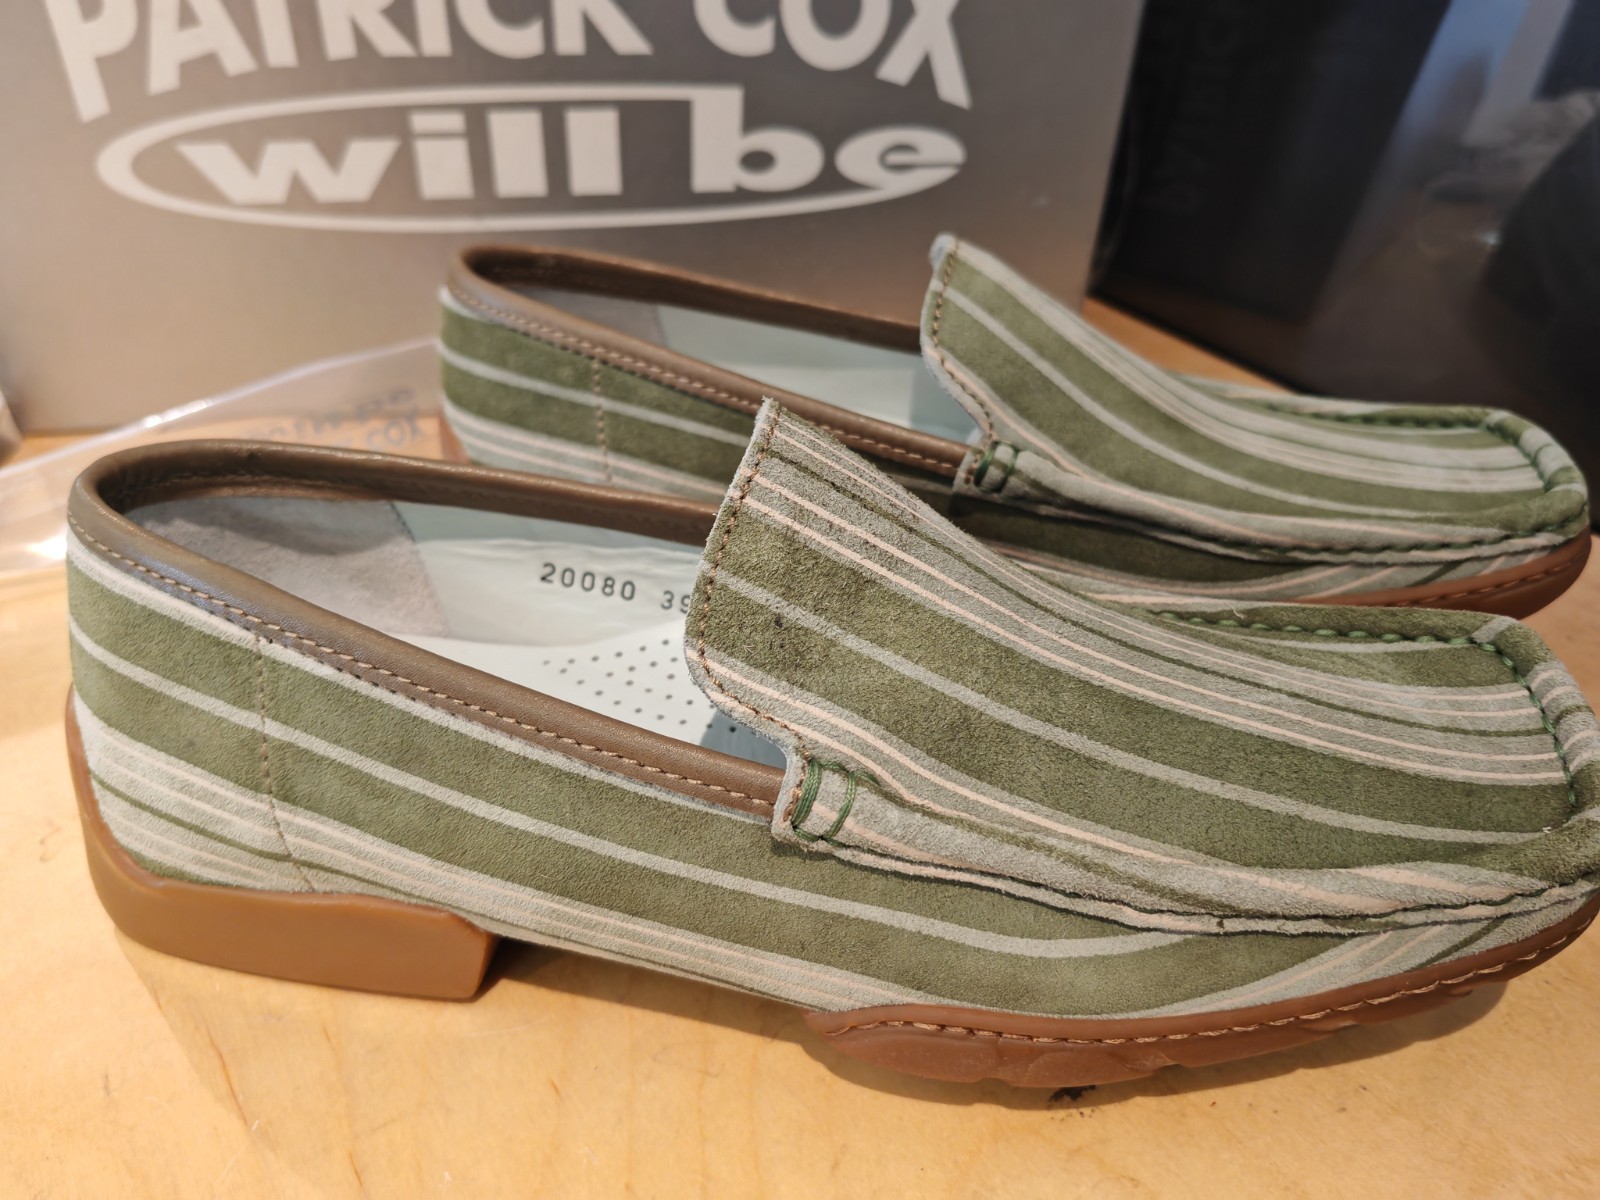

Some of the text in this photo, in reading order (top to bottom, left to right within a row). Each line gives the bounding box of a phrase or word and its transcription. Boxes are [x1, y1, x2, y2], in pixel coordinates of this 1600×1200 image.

[693, 0, 971, 110] COX
[175, 85, 967, 204] will be
[540, 562, 691, 615] 20080 39
